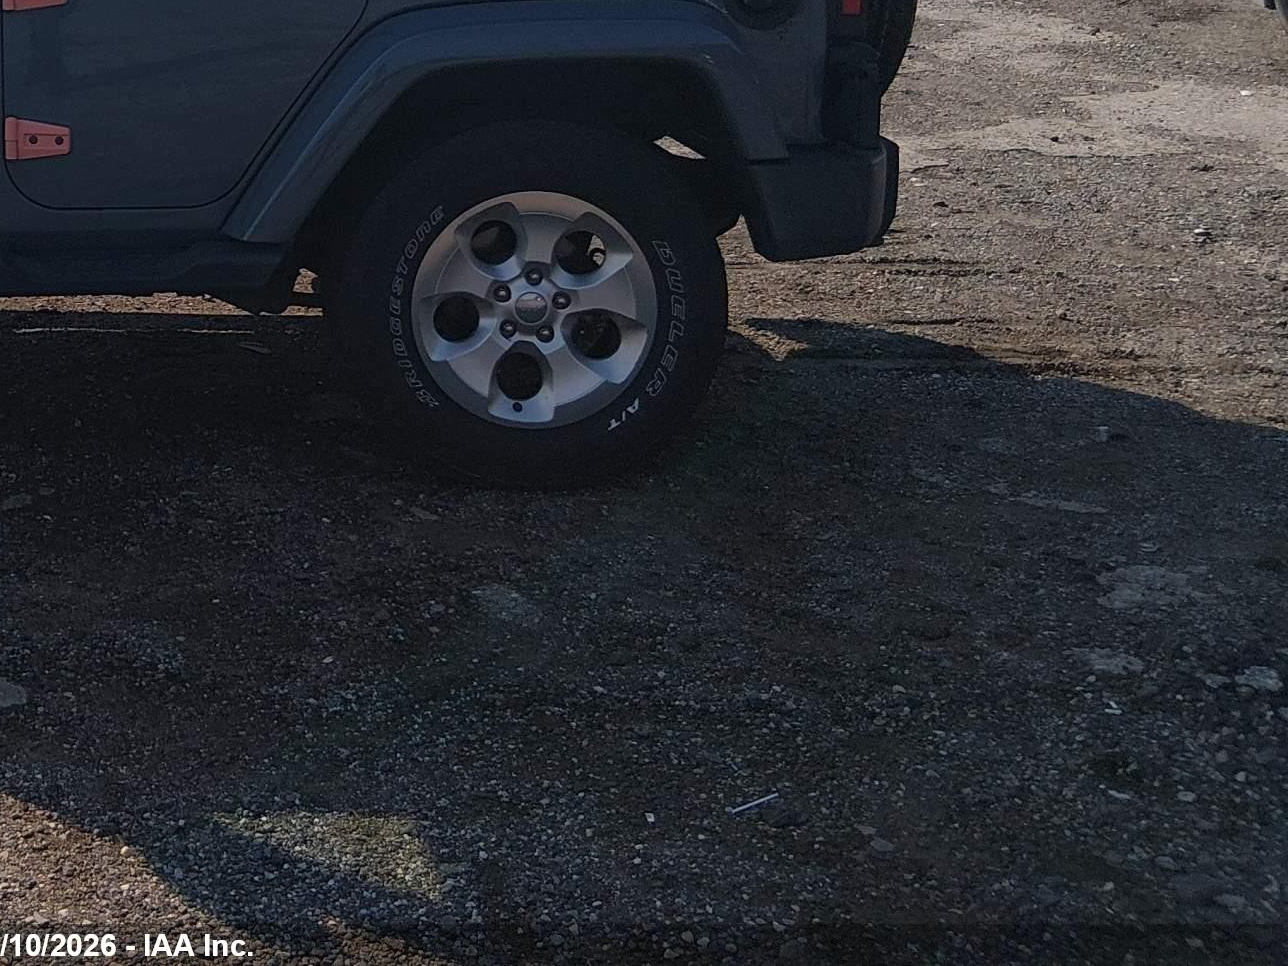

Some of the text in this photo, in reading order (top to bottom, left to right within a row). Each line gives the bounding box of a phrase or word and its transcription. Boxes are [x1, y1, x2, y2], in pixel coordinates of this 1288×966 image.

[388, 204, 447, 410] BRIDGESTONE
[606, 239, 689, 432] DUELER A/T
